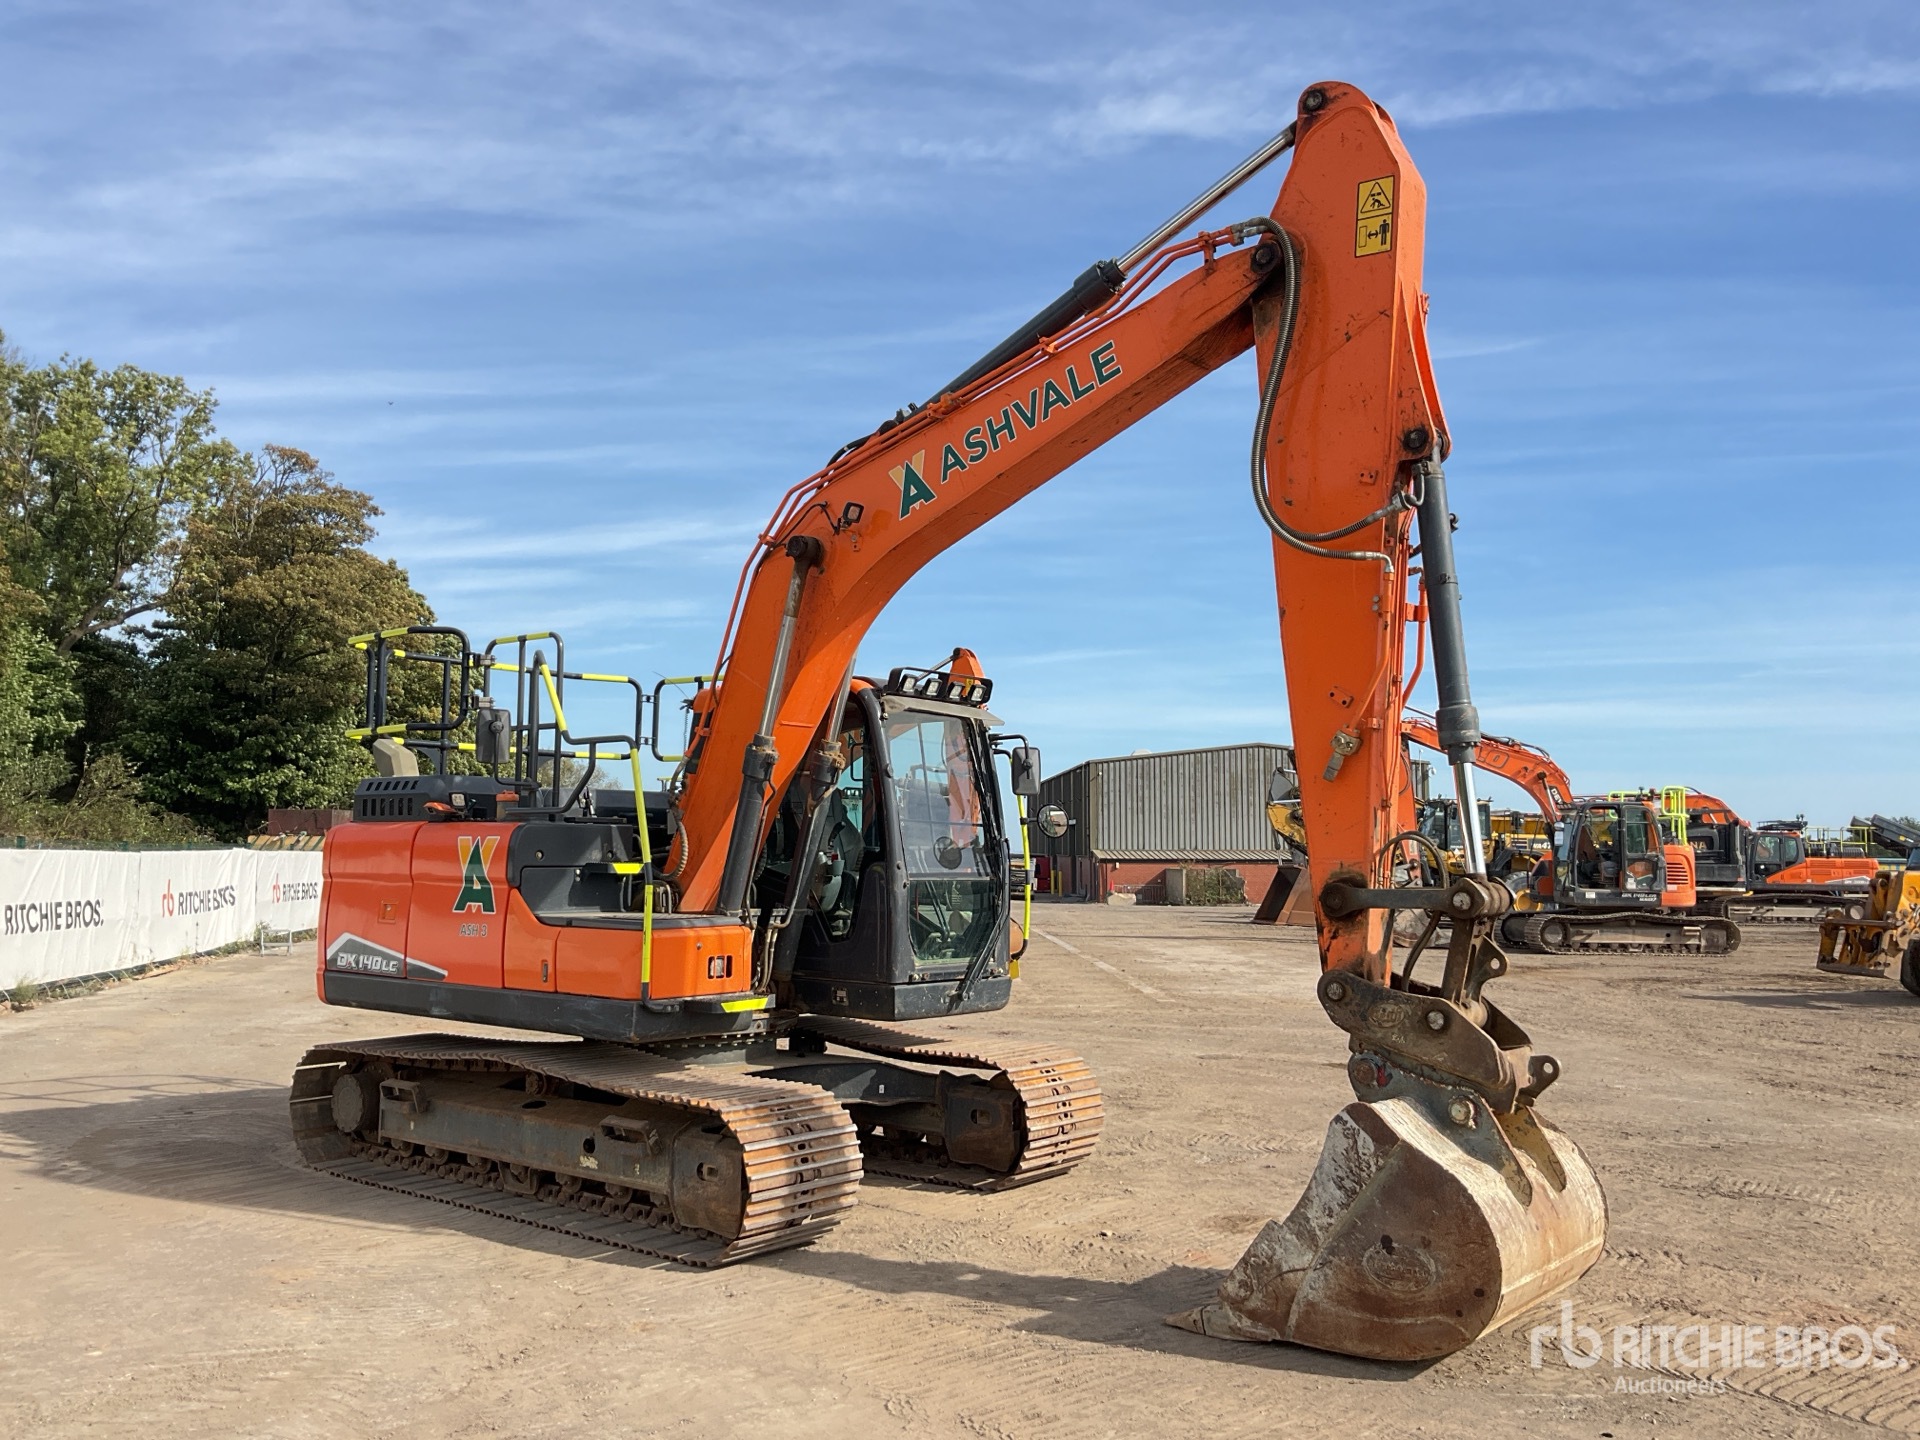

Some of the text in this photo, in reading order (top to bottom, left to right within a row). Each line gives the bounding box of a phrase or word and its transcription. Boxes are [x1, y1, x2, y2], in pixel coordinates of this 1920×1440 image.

[940, 340, 1122, 484] ASHVALE
[4, 898, 105, 936] RITCHIE BROS.
[178, 890, 211, 916] RITCHIE
[459, 923, 488, 938] ASH 3
